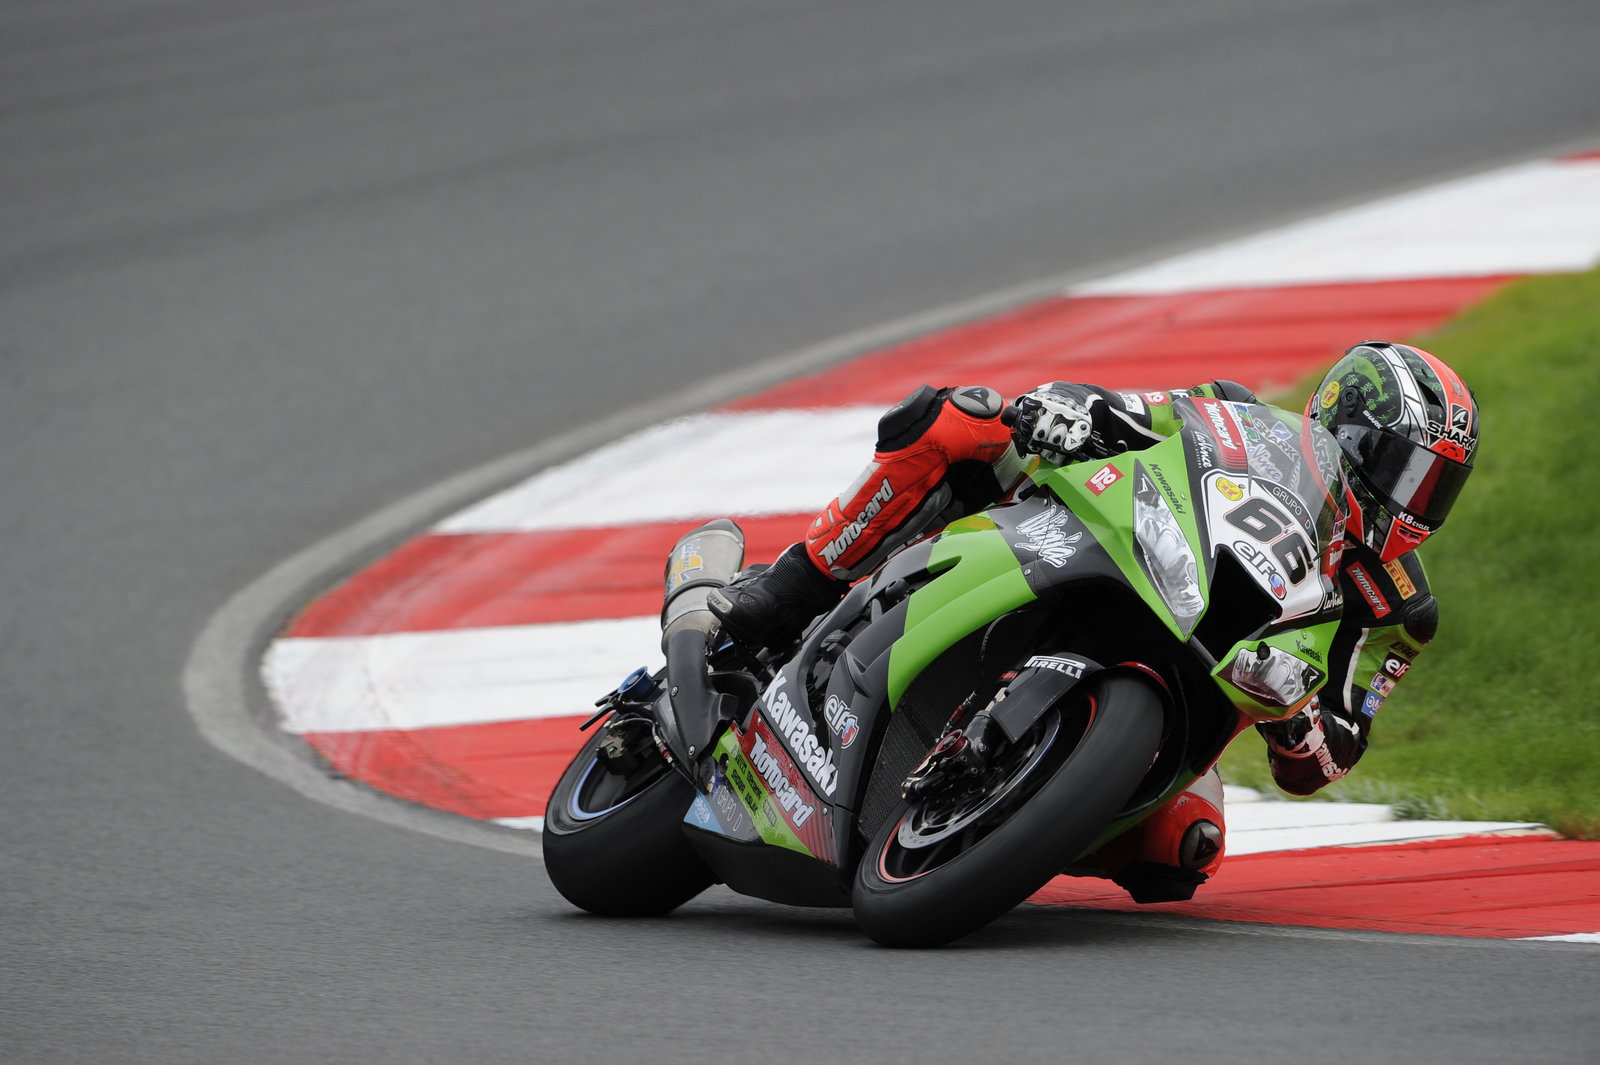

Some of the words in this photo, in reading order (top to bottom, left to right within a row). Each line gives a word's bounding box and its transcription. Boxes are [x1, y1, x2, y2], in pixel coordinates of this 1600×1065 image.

[1254, 418, 1300, 463] SHARK
[1363, 410, 1383, 430] SHARK
[1426, 420, 1477, 451] SHARK
[1149, 463, 1187, 515] Kawasaki
[1272, 486, 1302, 516] GRUPO
[818, 477, 895, 566] Motocard
[1223, 496, 1315, 587] 66
[1398, 511, 1414, 525] KB
[1412, 522, 1430, 531] CYCLES
[1233, 541, 1278, 577] elf
[1351, 567, 1388, 611] Motocard
[1023, 655, 1086, 680] PIRELLI
[1385, 658, 1411, 678] elf
[761, 668, 839, 797] Kawasaki
[824, 694, 855, 736] elf
[750, 731, 816, 829] Motocard
